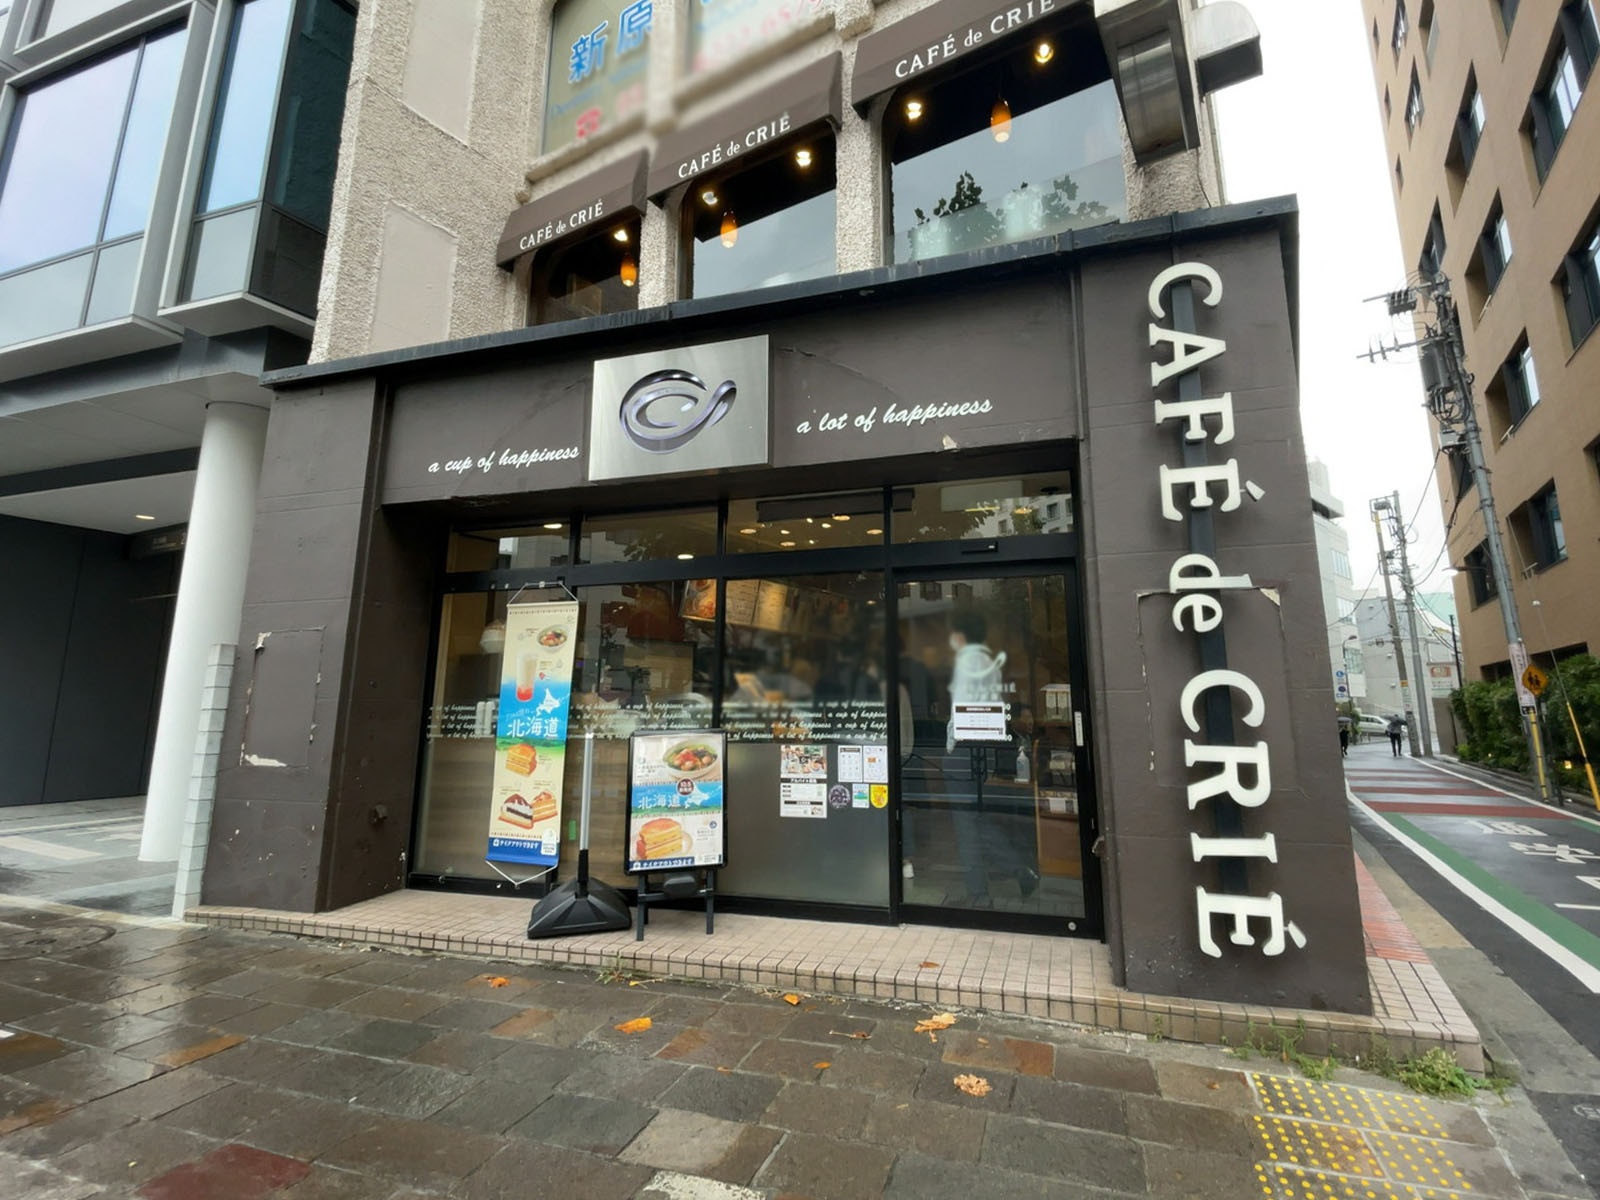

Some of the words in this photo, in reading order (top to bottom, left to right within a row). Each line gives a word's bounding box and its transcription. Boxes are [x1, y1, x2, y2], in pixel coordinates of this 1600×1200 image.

[894, 34, 957, 79] CAFÉ
[964, 28, 983, 47] de
[990, 0, 1055, 36] CRIÉ
[678, 143, 722, 178] CAFÉ
[726, 140, 741, 157] de
[745, 111, 791, 147] CRIÉ
[519, 220, 553, 250] CAFÉ
[555, 220, 567, 234] de
[569, 198, 603, 228] CRIÉ
[796, 420, 812, 434] a
[818, 412, 848, 432] lot
[854, 406, 877, 433] of
[882, 399, 994, 427] happiness
[1147, 261, 1266, 522] CAFÉ
[427, 461, 441, 473] a
[444, 456, 472, 475] cup
[477, 450, 496, 473] of
[498, 446, 580, 469] happiness
[1168, 552, 1252, 634] de
[506, 716, 560, 739] 北海道
[638, 793, 681, 810] 北海道
[1179, 668, 1307, 960] CRIÉ
